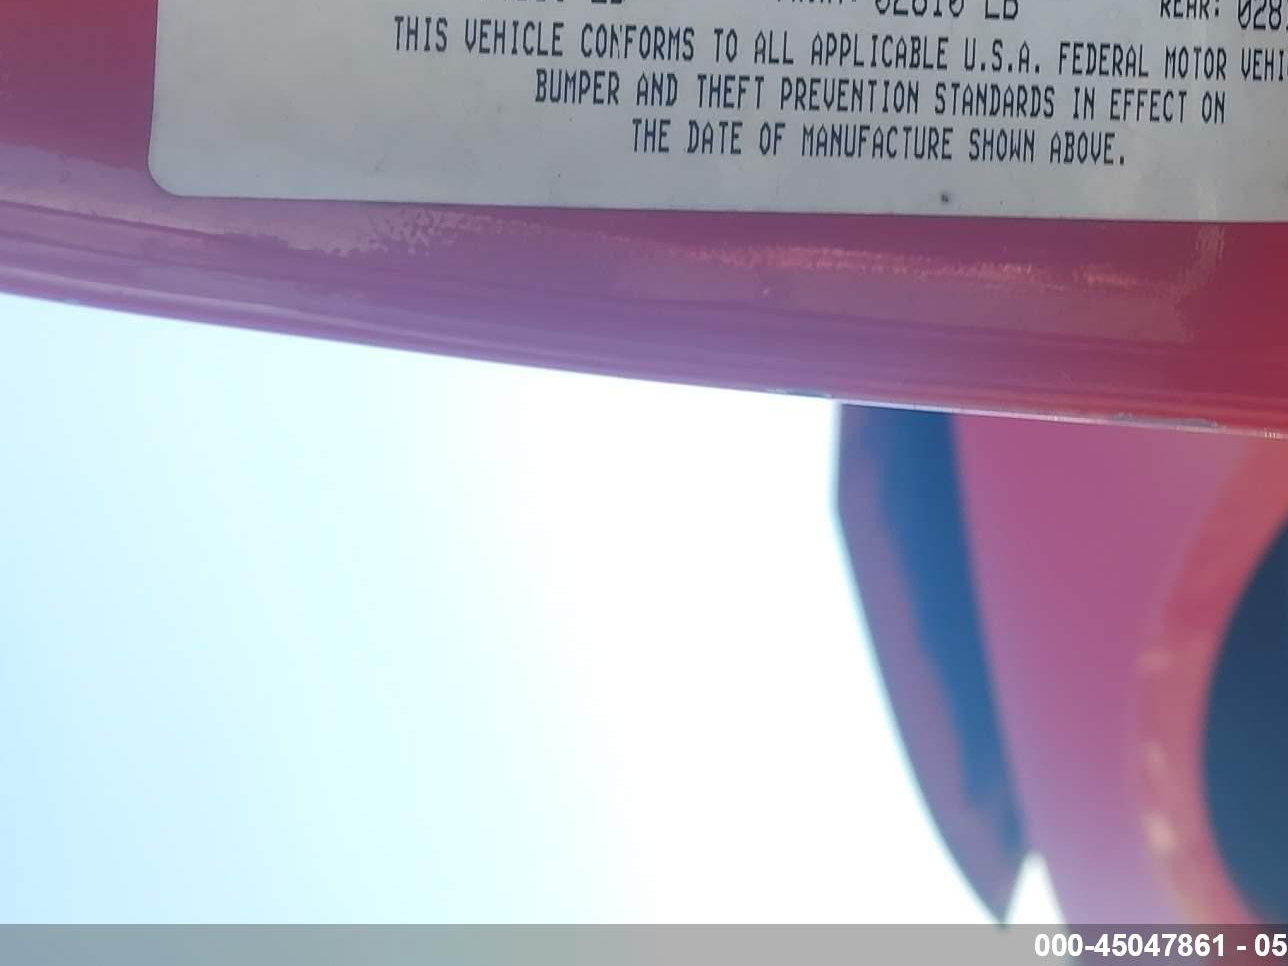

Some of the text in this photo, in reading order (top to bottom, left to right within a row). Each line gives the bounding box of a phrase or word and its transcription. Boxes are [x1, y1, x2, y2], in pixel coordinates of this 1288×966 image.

[394, 16, 448, 52] THIS
[465, 18, 564, 57] VEHICLE
[581, 23, 695, 61] CONFORMS
[714, 28, 737, 63] TO
[754, 30, 794, 65] ALL
[811, 32, 949, 70] APPLICABLE
[964, 37, 1039, 74] U.S.A.
[1059, 41, 1149, 78] FEDERAL
[1165, 46, 1226, 81] MOTOR
[535, 68, 1225, 124] BUMPER AND THEFT PREVENTION STANDARDS IN EFFECT ON
[632, 118, 1124, 166] THE DATE OF MANUFACTURE SHOWN ABOVE.
